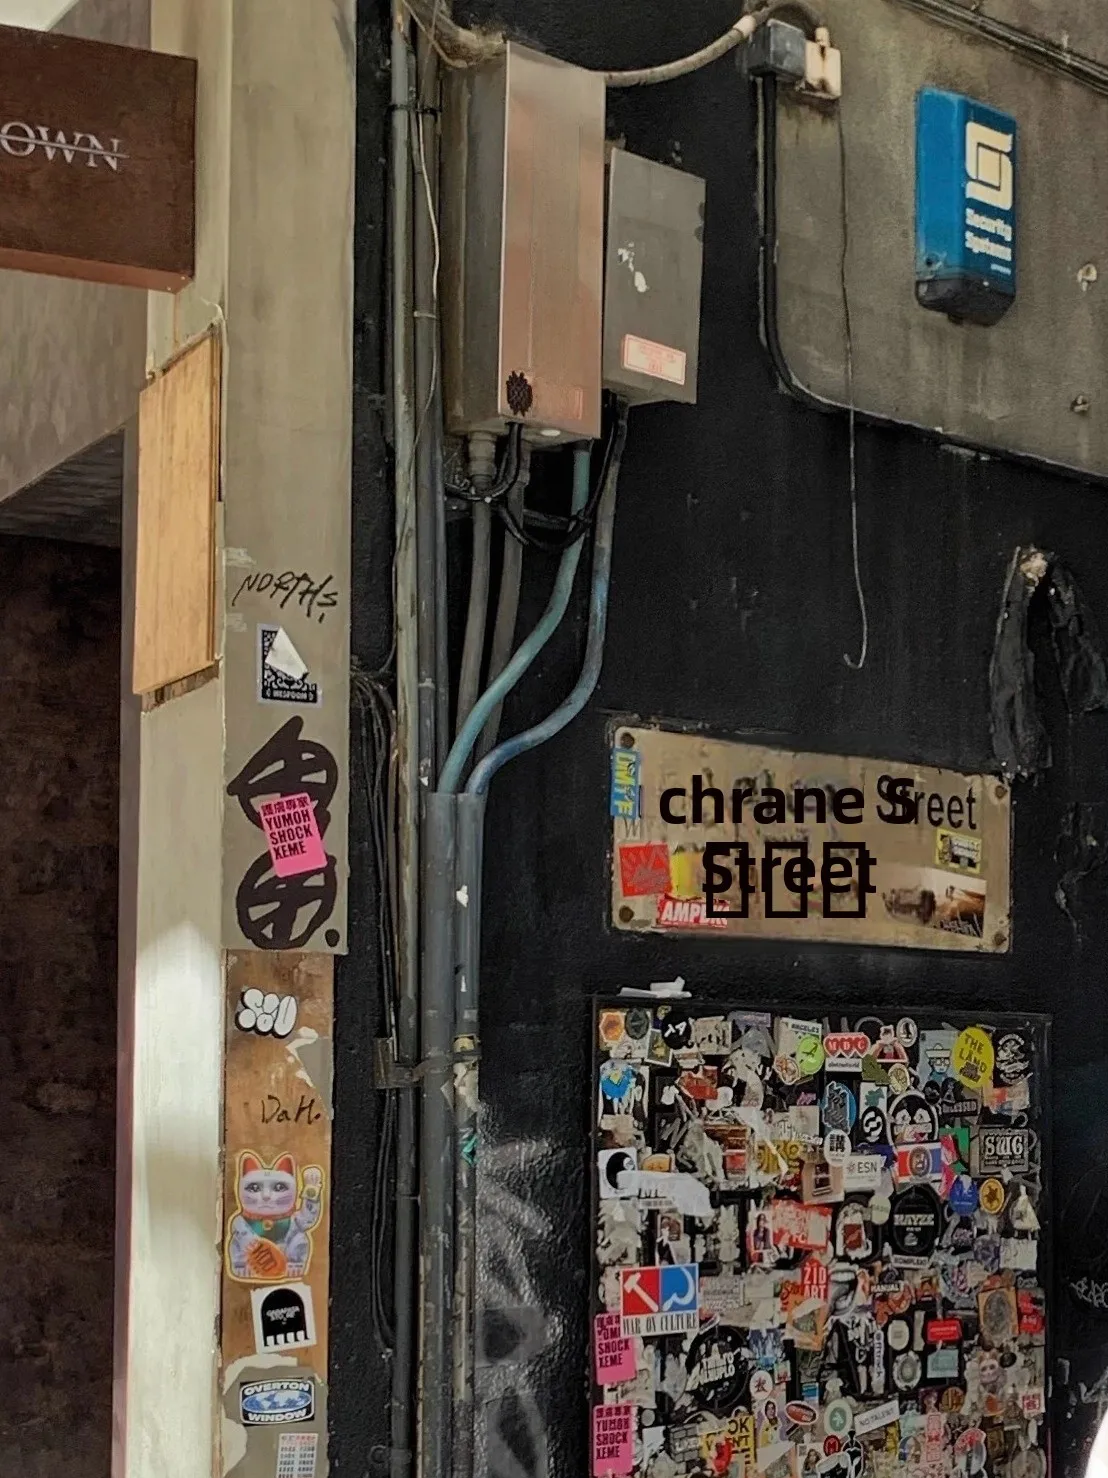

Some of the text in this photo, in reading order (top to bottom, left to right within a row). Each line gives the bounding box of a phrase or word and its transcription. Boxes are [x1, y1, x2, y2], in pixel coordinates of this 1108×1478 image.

[0, 121, 125, 171] OWN
[658, 774, 864, 824] chrane
[264, 811, 311, 833] YUMOH
[269, 826, 314, 846] SHOCK
[272, 842, 307, 860] XEME
[702, 842, 877, 893] Street
[964, 1033, 985, 1053] THE
[857, 1161, 878, 1174] ESN
[623, 1312, 698, 1335] WAR ON CULTURE
[597, 1337, 631, 1355] SHOCK
[598, 1353, 624, 1369] XEME
[243, 1381, 310, 1397] OVERTON
[247, 1408, 308, 1423] WINDOW
[595, 1432, 628, 1446] SHOCK
[596, 1445, 621, 1460] XEME
